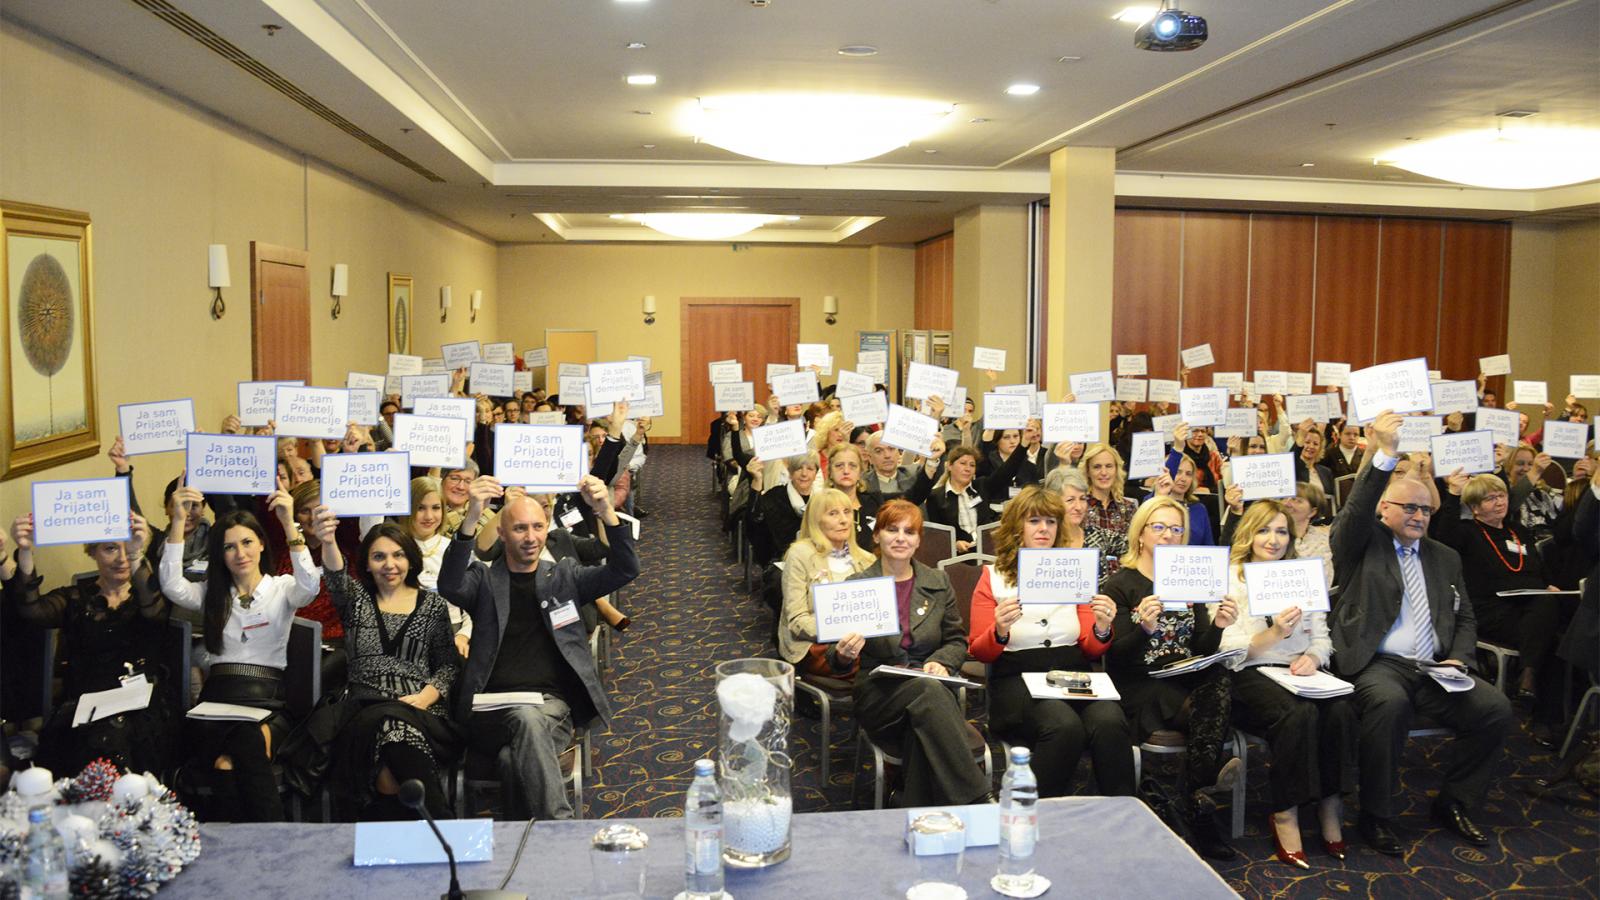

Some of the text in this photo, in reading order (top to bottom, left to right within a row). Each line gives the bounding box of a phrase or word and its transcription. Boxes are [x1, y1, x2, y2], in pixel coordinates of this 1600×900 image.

[292, 394, 305, 402] Ja
[136, 409, 176, 419] Ja sam
[290, 403, 333, 416] Prijatelj
[135, 417, 179, 430] Prijatelj
[281, 413, 341, 426] demencije
[411, 422, 424, 431] Ja
[128, 427, 188, 441] demencije
[409, 432, 451, 445] Prijatelj
[516, 433, 562, 444] Ja sam
[207, 443, 255, 453] Ja sam
[400, 442, 458, 455] demencije
[514, 445, 564, 459] Prijatelj
[205, 454, 257, 468] Prijatelj
[504, 457, 573, 471] demencije
[1439, 453, 1489, 465] demencije
[195, 466, 267, 479] demencije
[341, 462, 389, 473] Ja sam
[1246, 468, 1282, 479] Prijatelj
[339, 474, 391, 487] Prijatelj
[1240, 477, 1289, 488] demencije
[55, 489, 106, 500] Ja sam
[329, 485, 401, 499] demencije
[54, 500, 109, 514] Prijatelj
[43, 512, 120, 527] demencije
[1037, 556, 1051, 566] Ja
[1172, 554, 1185, 563] Ja
[1035, 567, 1081, 579] Prijatelj
[1170, 564, 1213, 577] Prijatelj
[1264, 568, 1305, 578] Ja sam
[1026, 578, 1089, 590] demencije
[1162, 576, 1222, 588] demencije
[1263, 577, 1309, 590] Prijatelj
[833, 588, 876, 600] Ja sam
[1255, 587, 1319, 600] demencije
[832, 598, 879, 613] Prijatelj
[824, 609, 889, 625] demencije
